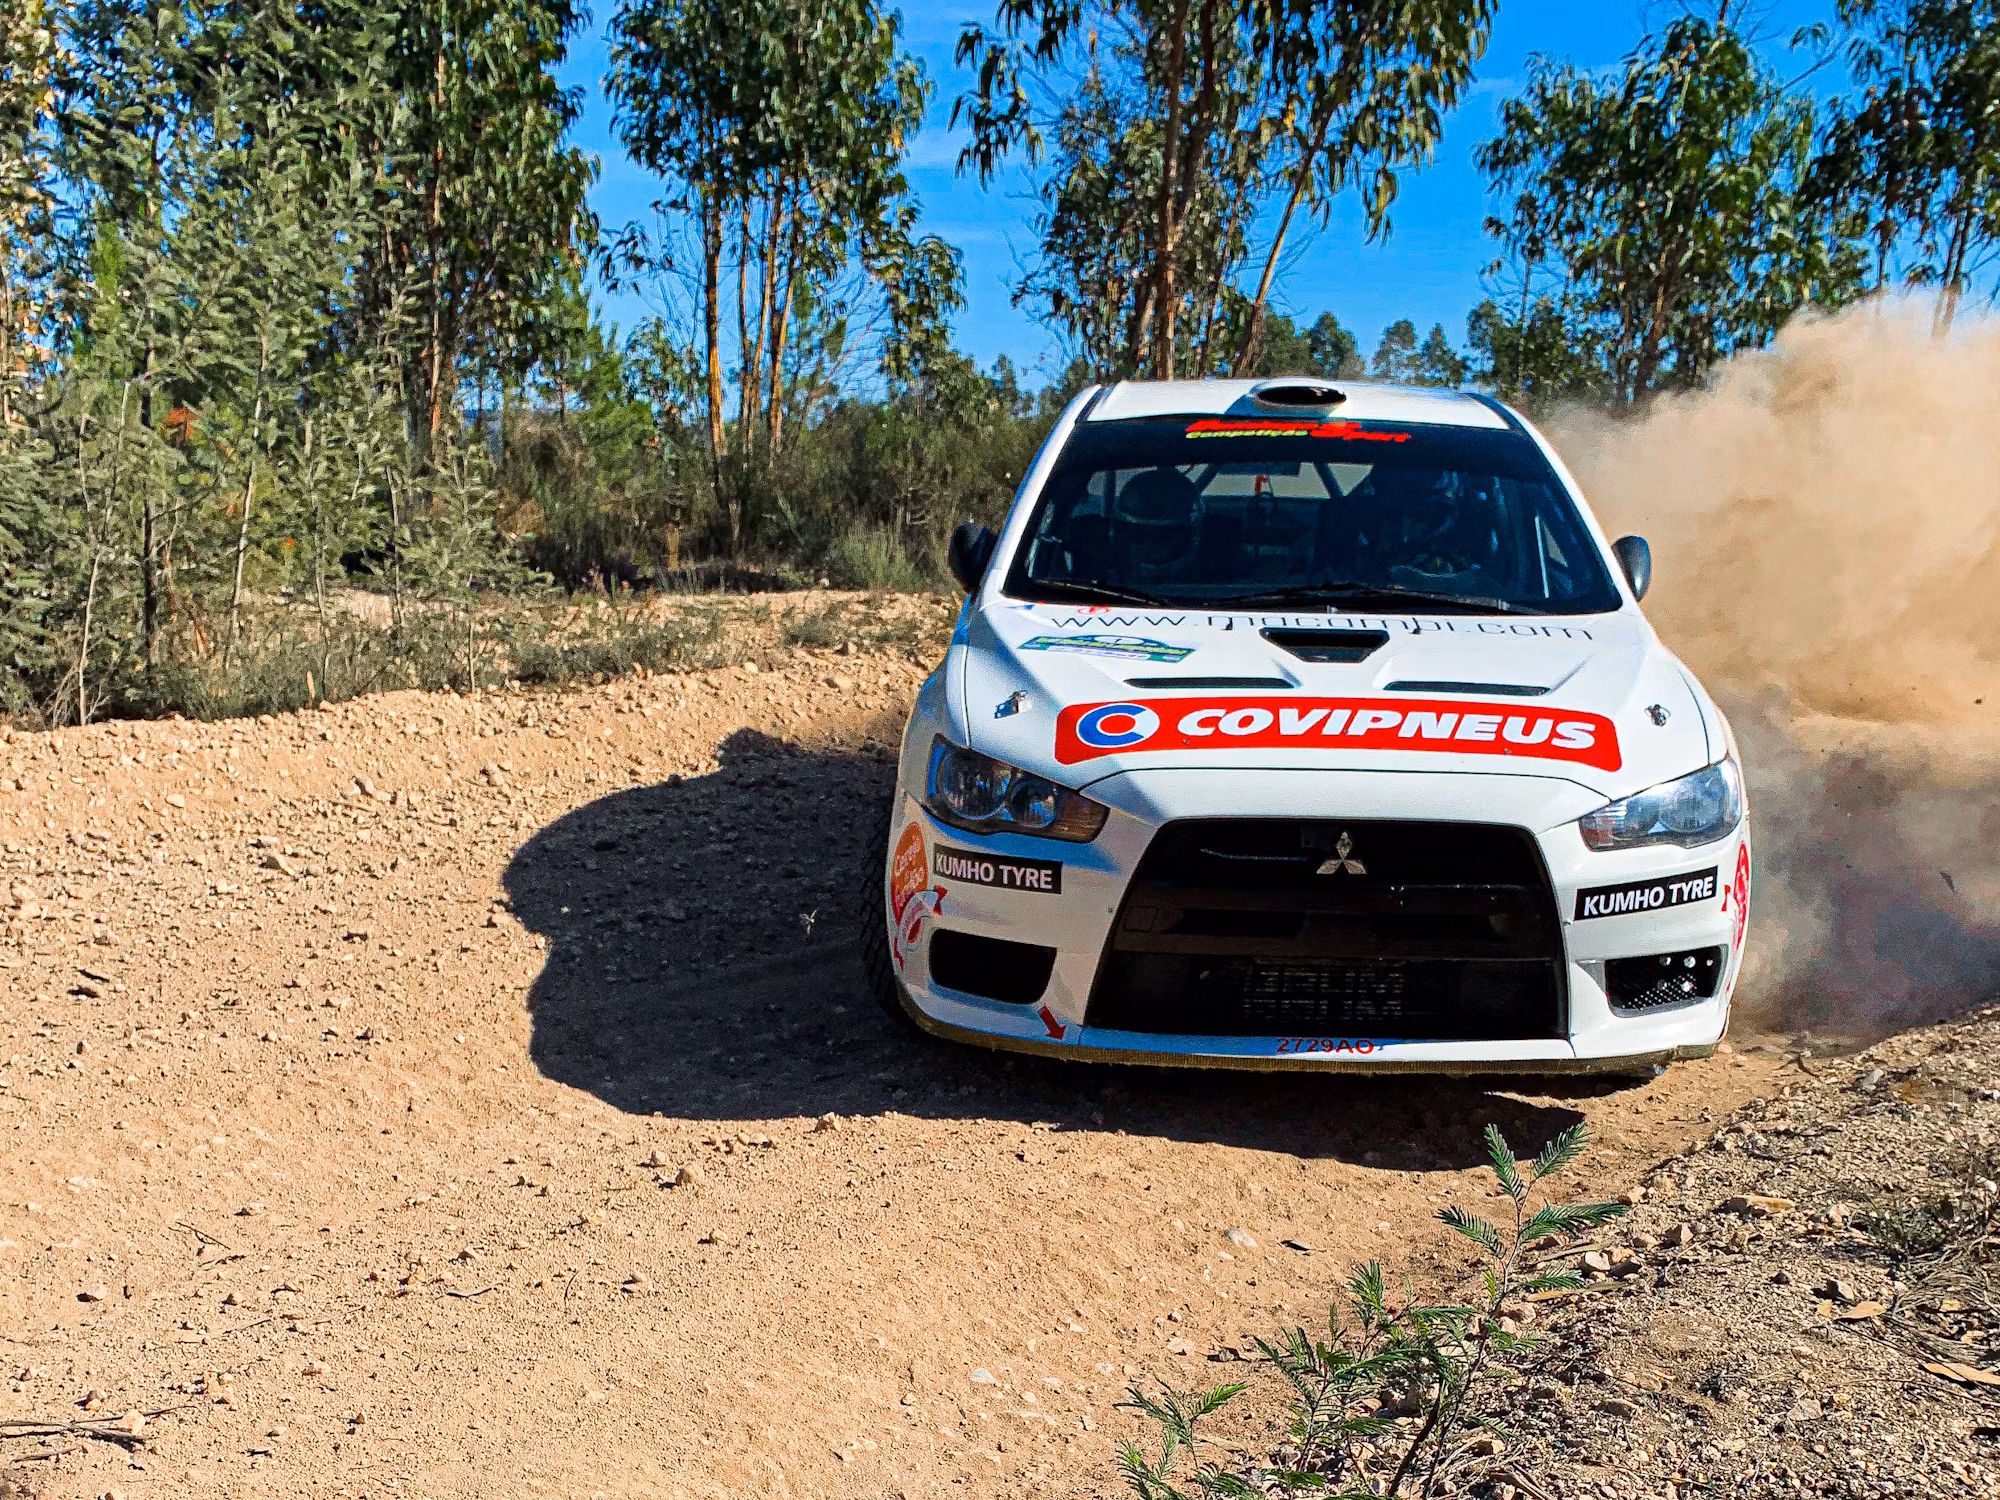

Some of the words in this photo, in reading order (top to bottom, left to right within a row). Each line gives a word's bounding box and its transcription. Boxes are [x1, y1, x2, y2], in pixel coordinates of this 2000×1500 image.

[1177, 707, 1597, 750] COVIPNEUS
[936, 852, 996, 883] KUMHO
[999, 864, 1053, 890] TYRE
[1583, 886, 1665, 917] KUMHO
[1669, 875, 1714, 904] TYRE
[1275, 1037, 1376, 1055] 2729AO
